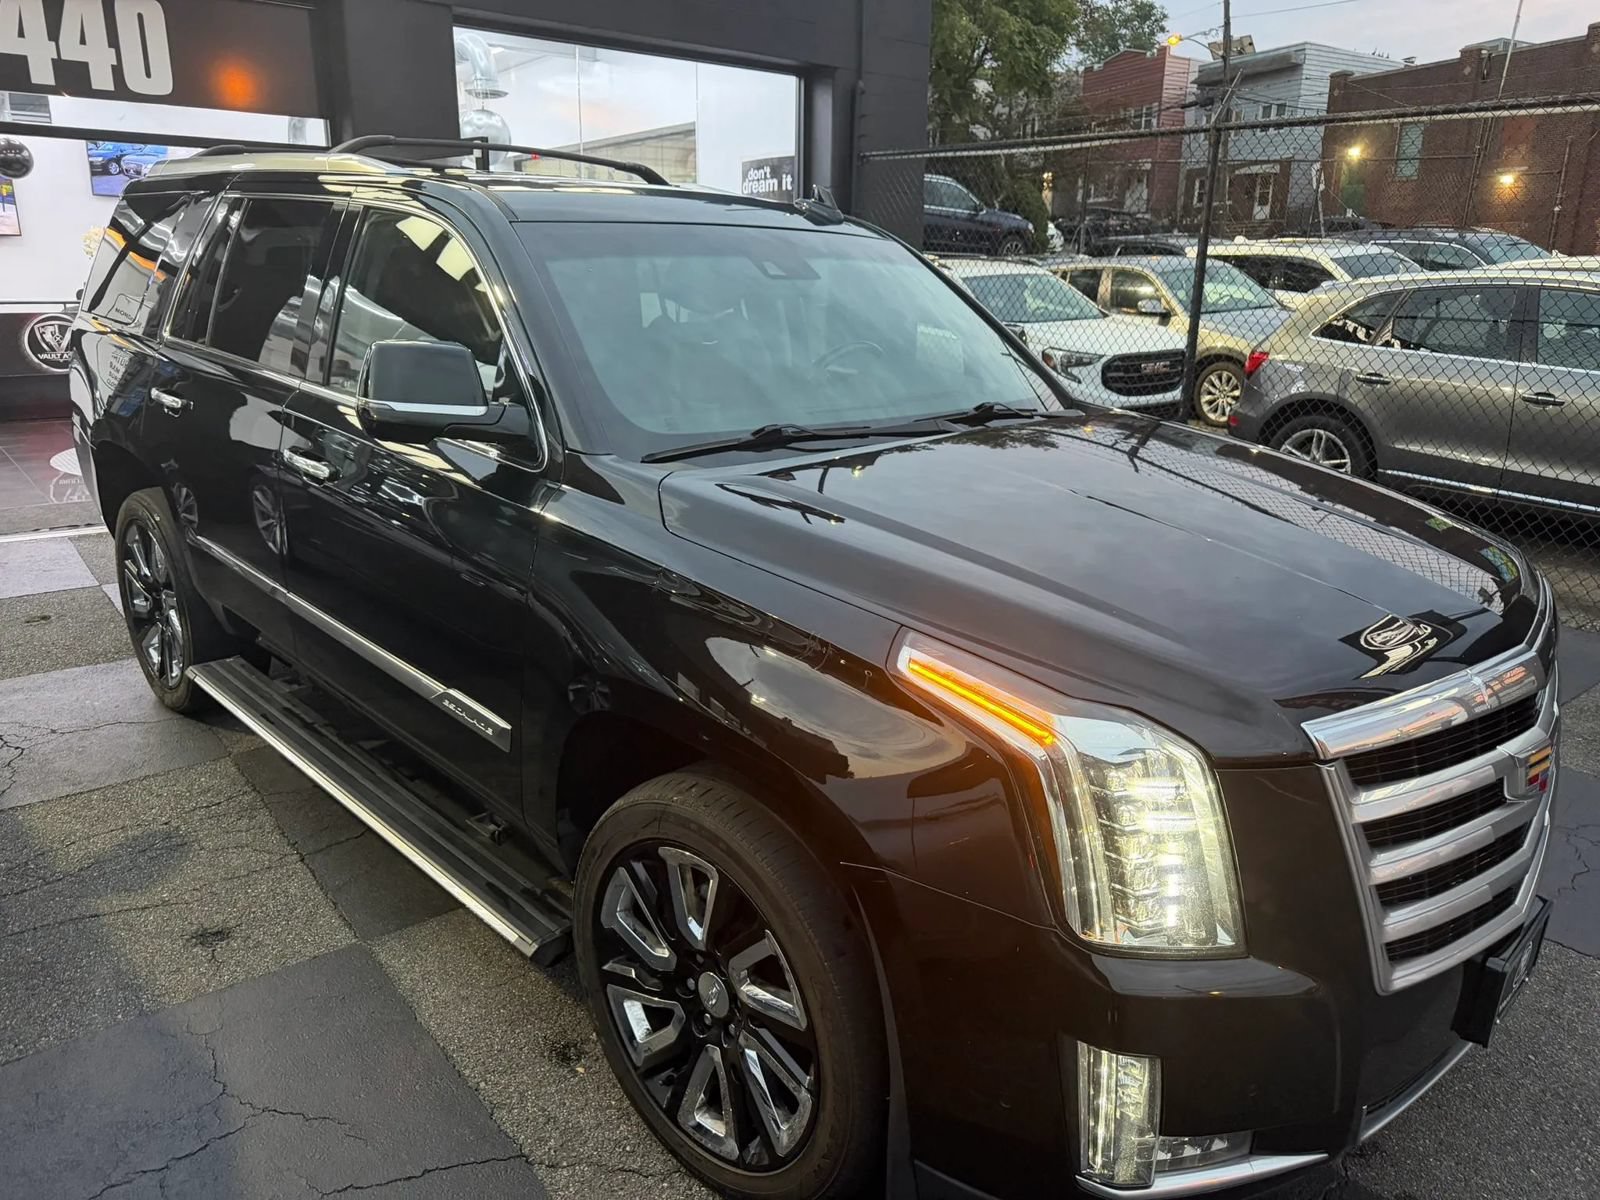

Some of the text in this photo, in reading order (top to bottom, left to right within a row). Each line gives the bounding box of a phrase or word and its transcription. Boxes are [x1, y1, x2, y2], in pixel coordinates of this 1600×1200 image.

[0, 0, 173, 95] 440
[748, 165, 770, 180] don't
[743, 173, 793, 194] dream it
